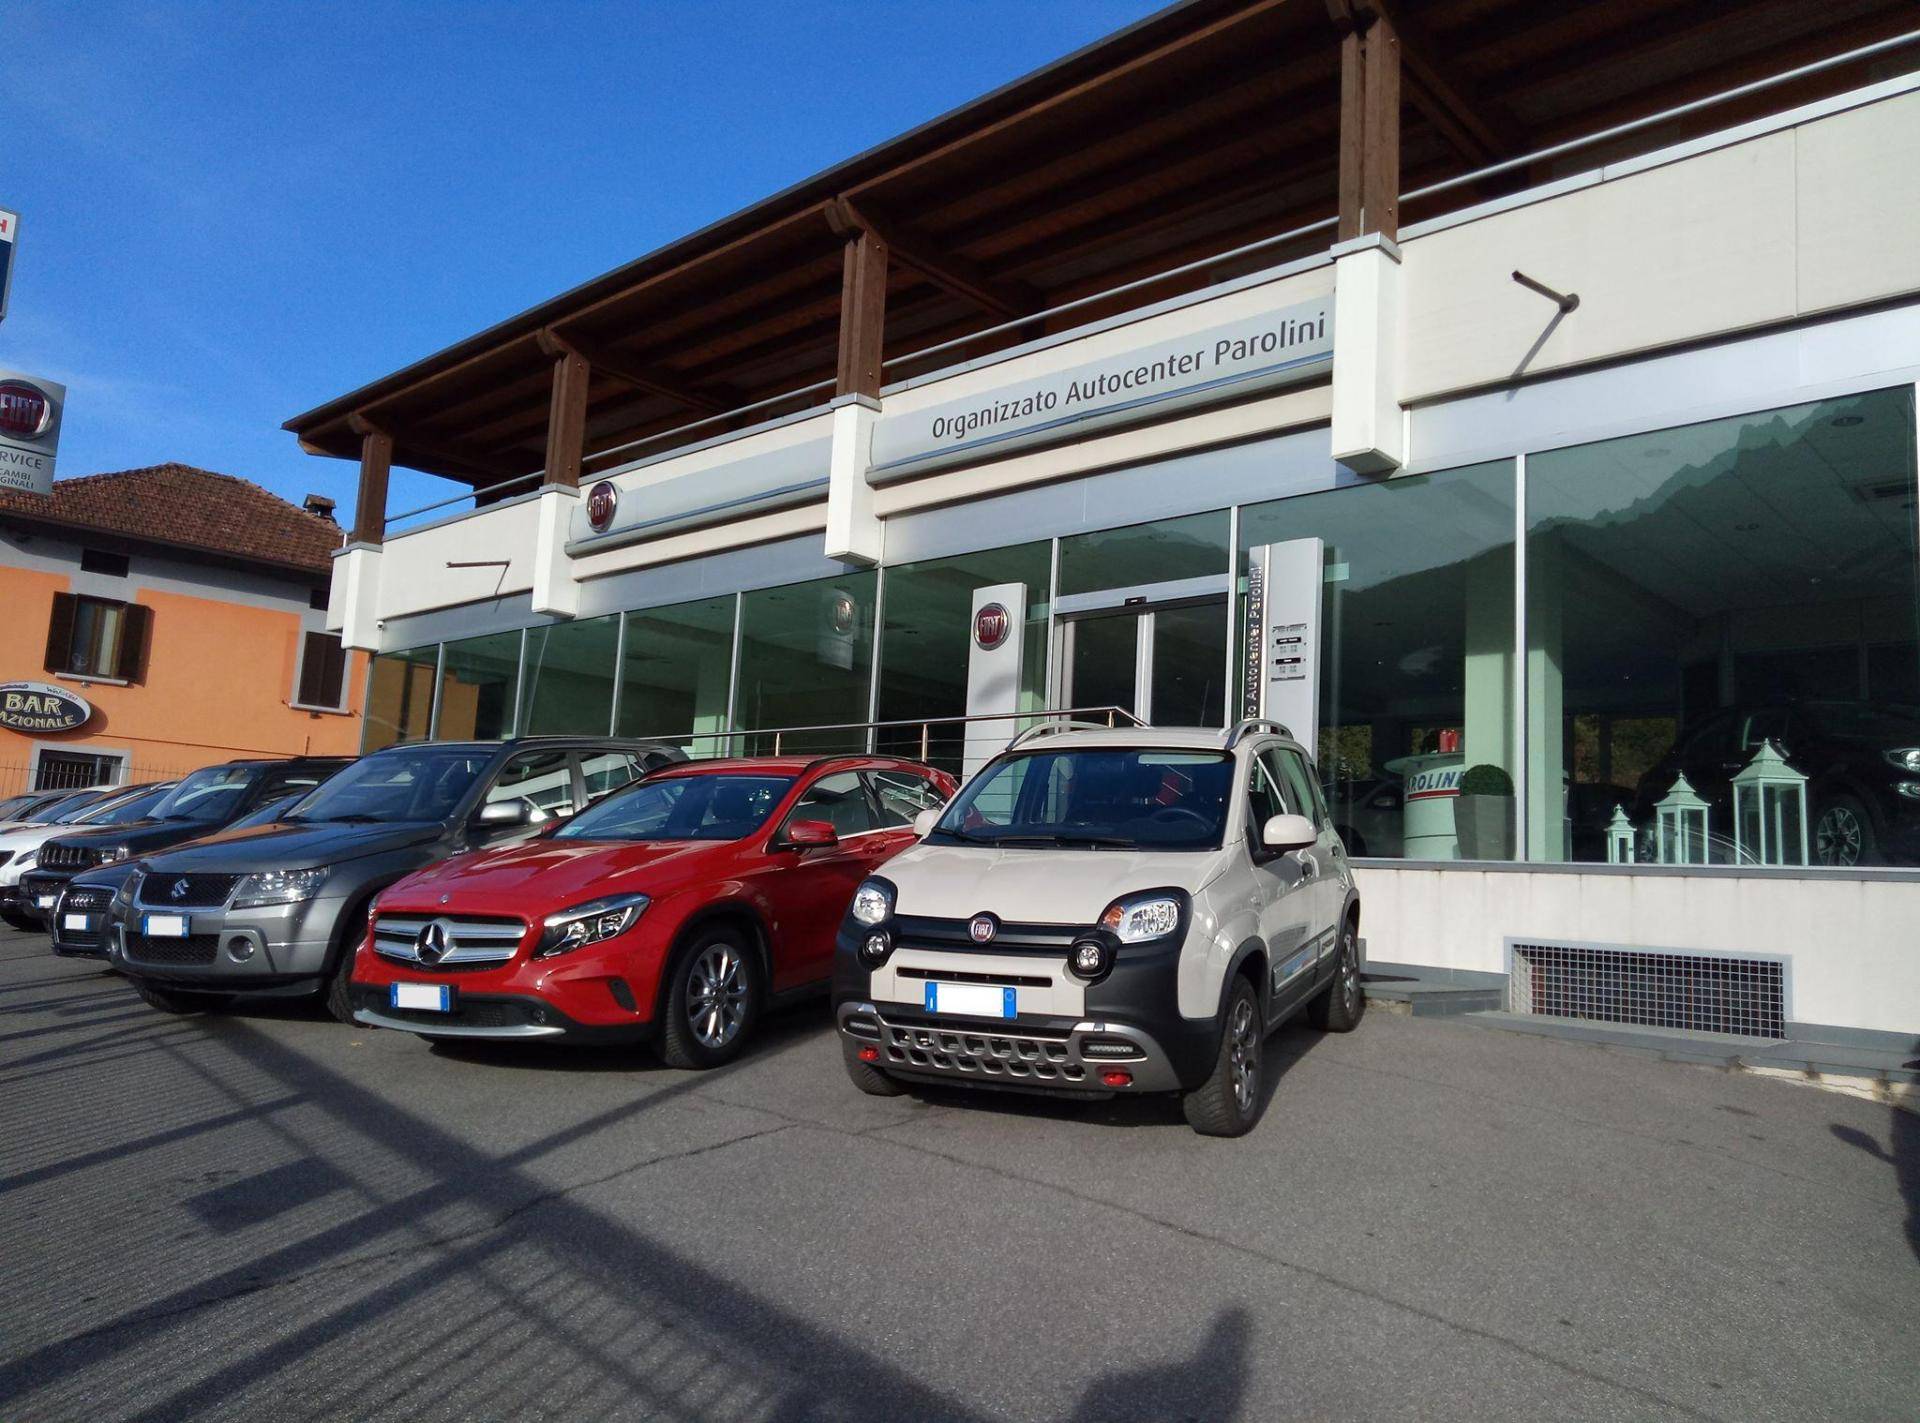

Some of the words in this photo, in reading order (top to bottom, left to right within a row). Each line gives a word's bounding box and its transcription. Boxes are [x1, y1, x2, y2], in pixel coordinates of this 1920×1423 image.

[932, 390, 1057, 439] Organizzato
[1065, 350, 1205, 405] Autocenter
[1215, 311, 1326, 366] Parolini
[979, 615, 1001, 638] FIAT
[5, 693, 62, 716] BAR
